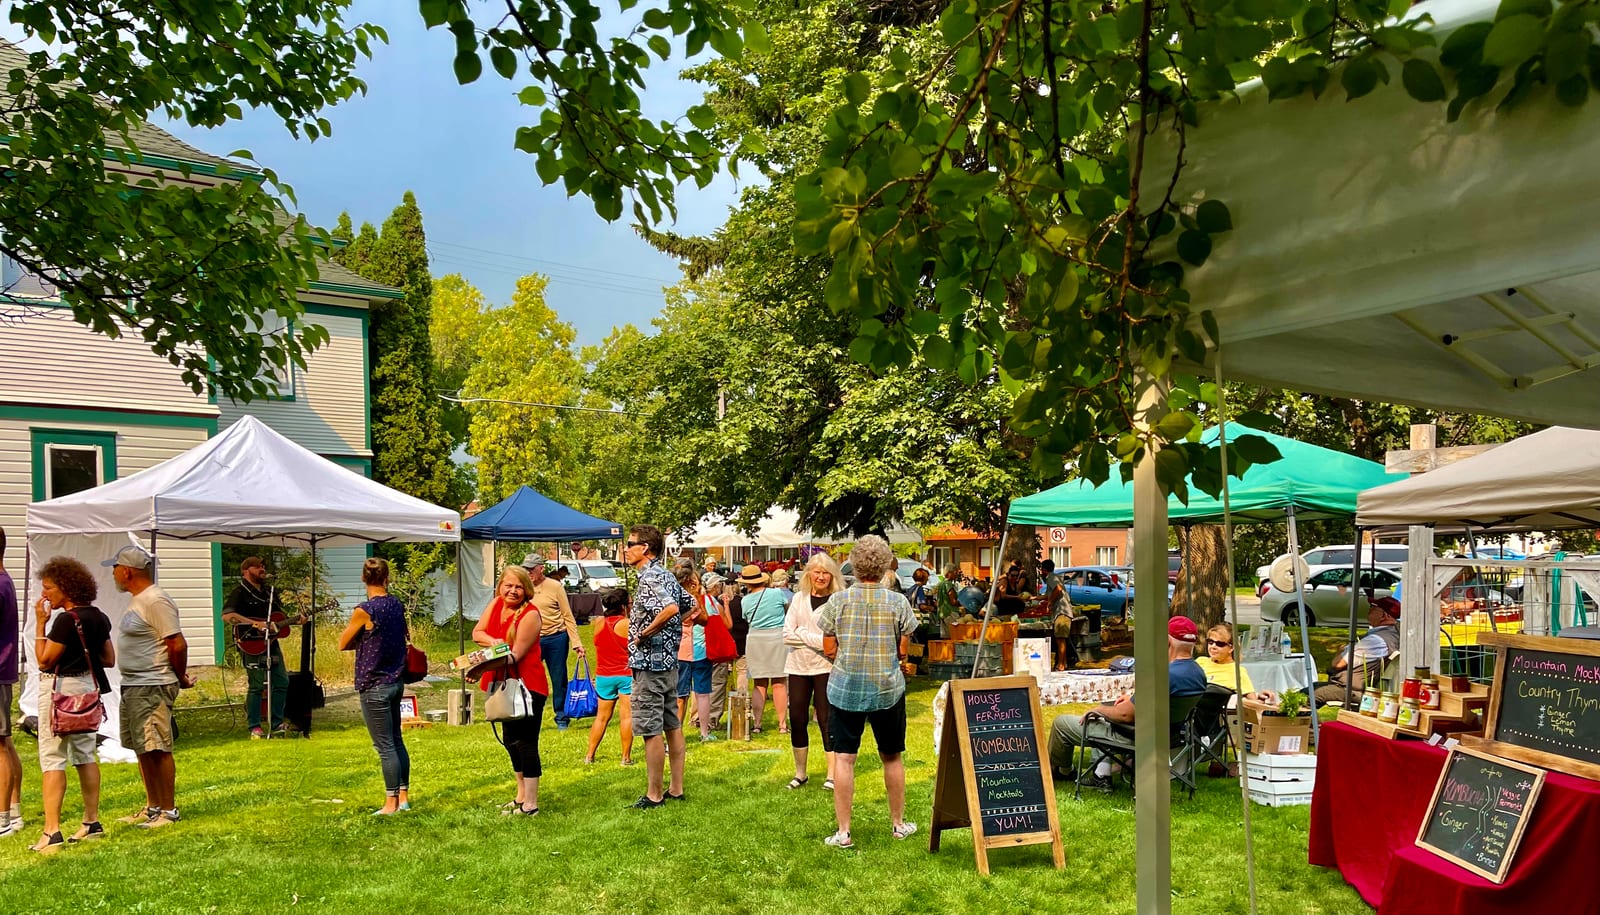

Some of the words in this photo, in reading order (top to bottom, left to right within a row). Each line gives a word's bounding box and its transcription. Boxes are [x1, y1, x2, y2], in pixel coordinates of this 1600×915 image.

[1512, 655, 1567, 673] Mountain
[967, 693, 1001, 706] HOUSE
[1518, 680, 1561, 707] Country
[1566, 687, 1600, 716] Thym
[976, 707, 1022, 722] FERMENTS
[990, 703, 1001, 713] of
[1547, 705, 1571, 720] Ginger
[1550, 716, 1576, 728] Lemon
[1551, 724, 1575, 738] Thyme
[972, 736, 1032, 758] KOMBUCHA
[980, 776, 1020, 789] Mountain
[994, 814, 1034, 832] YUM!
[1441, 810, 1469, 833] Ginger
